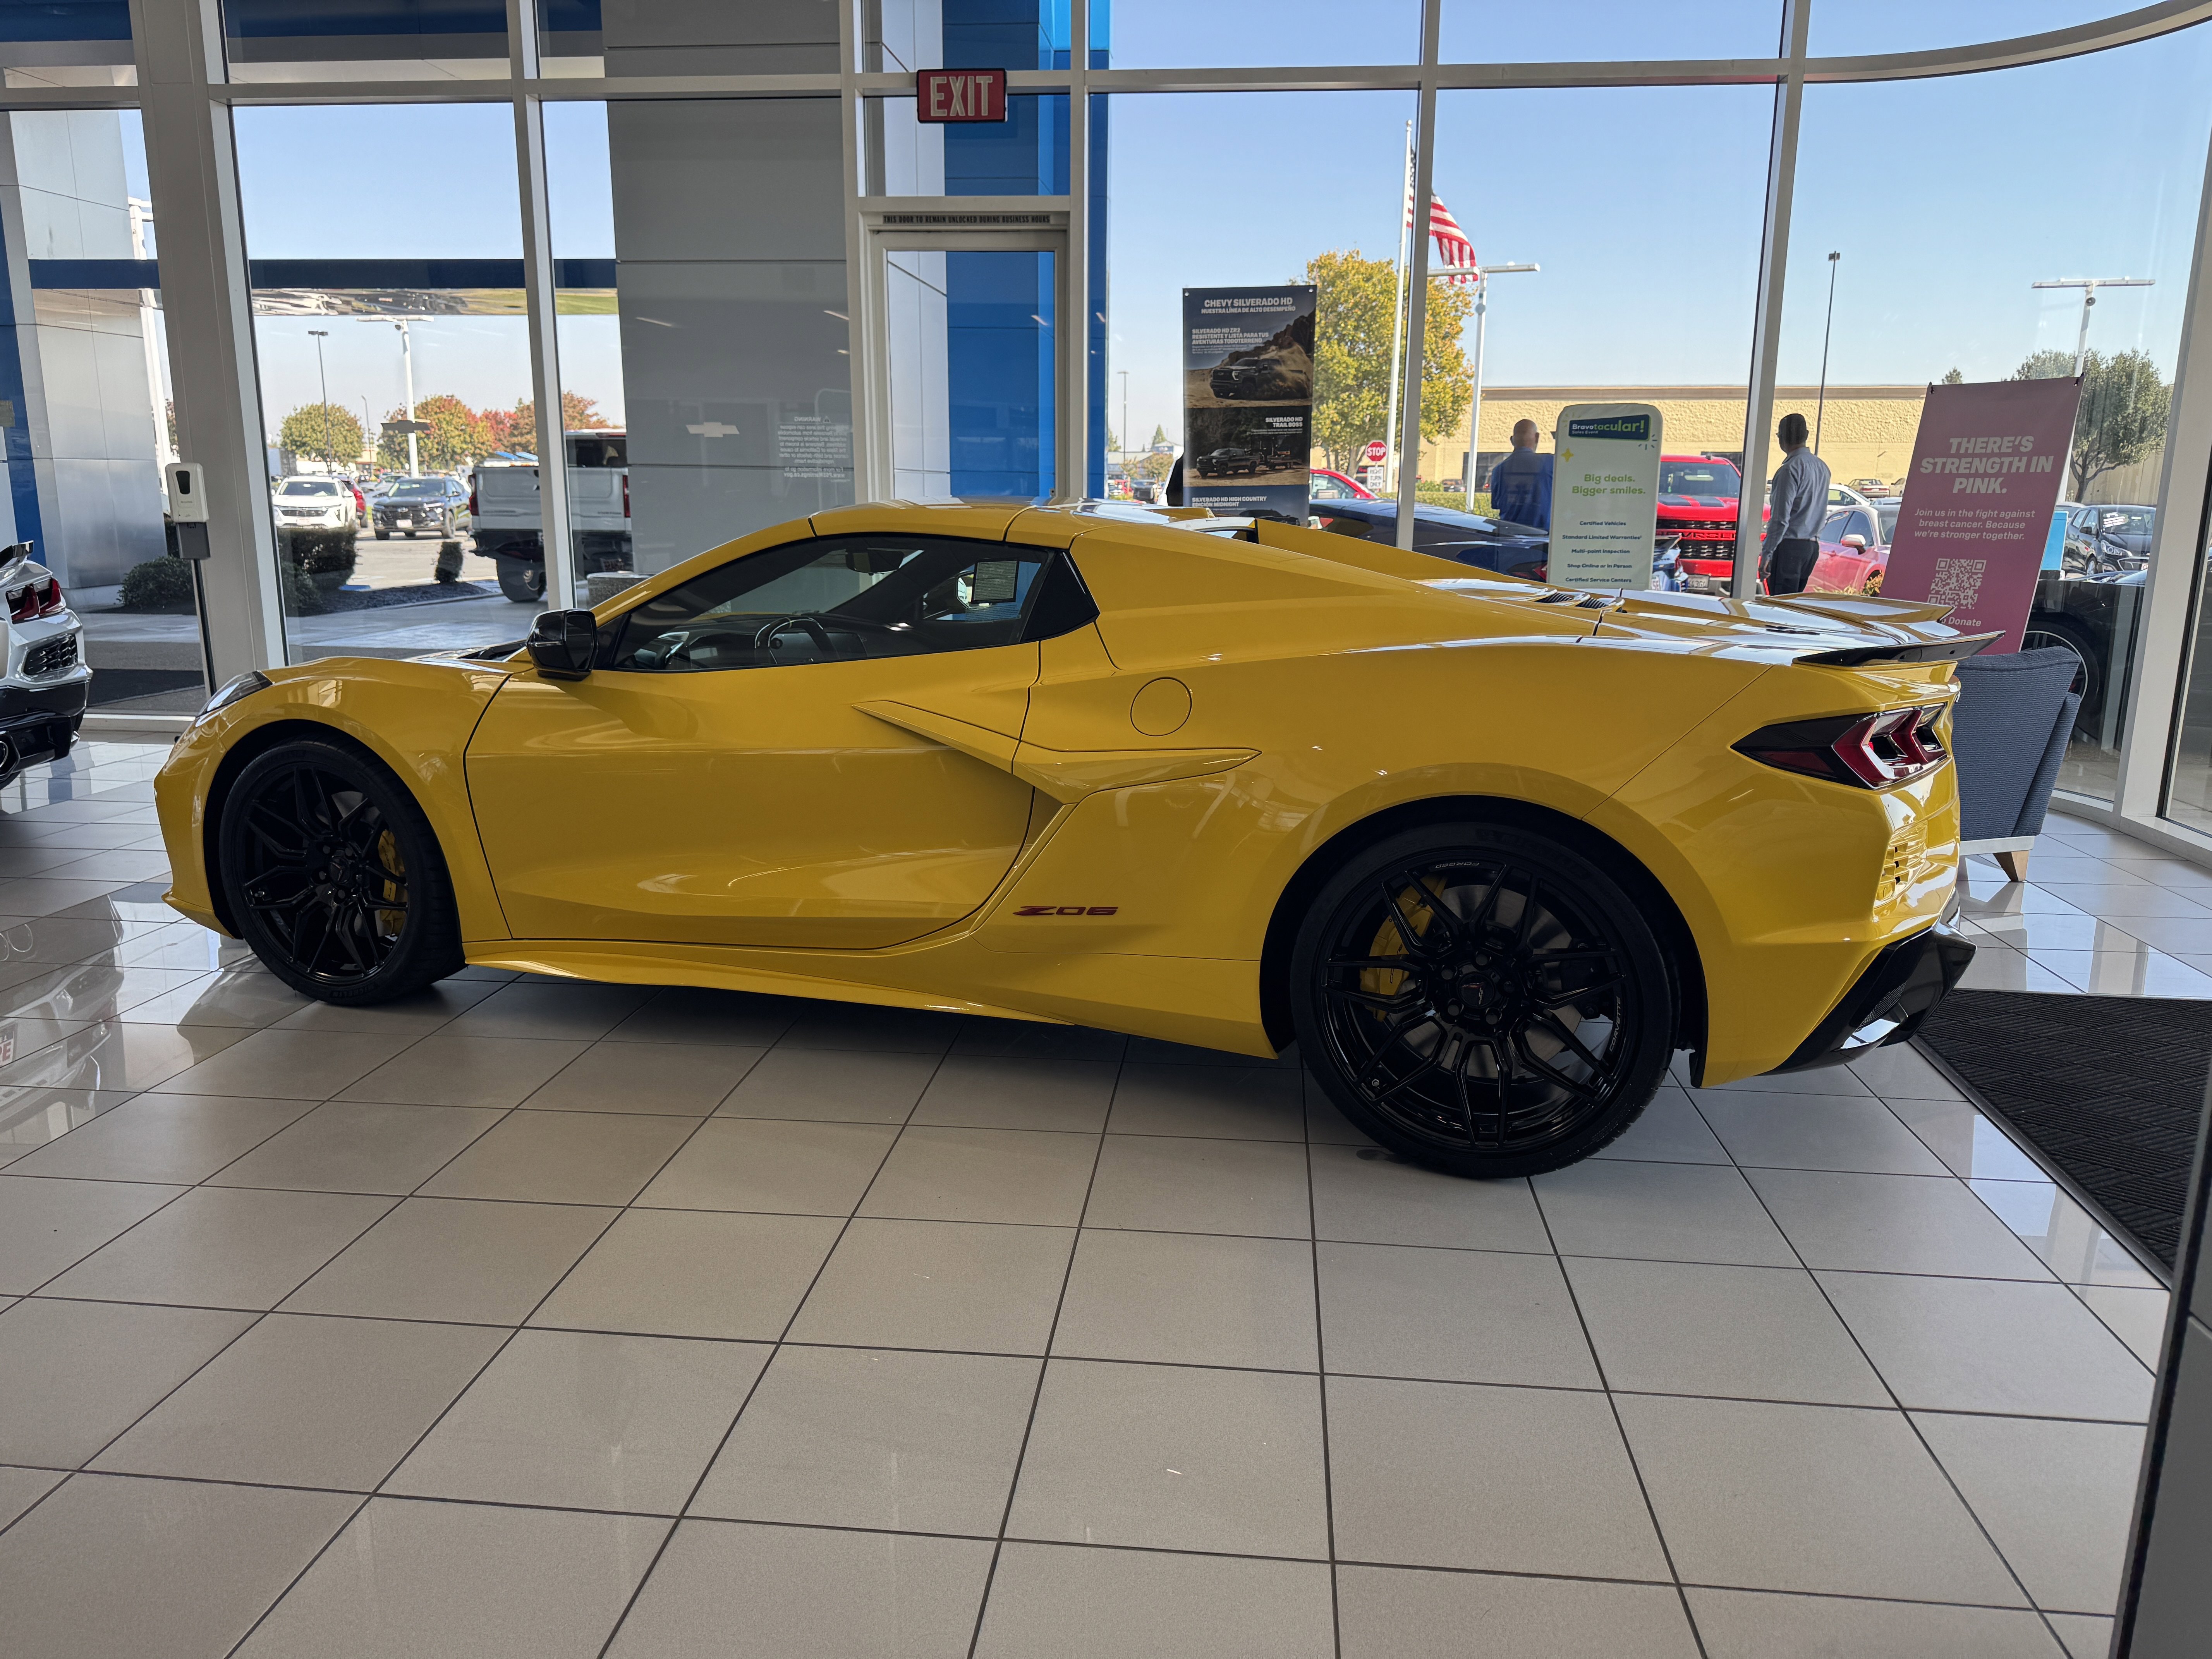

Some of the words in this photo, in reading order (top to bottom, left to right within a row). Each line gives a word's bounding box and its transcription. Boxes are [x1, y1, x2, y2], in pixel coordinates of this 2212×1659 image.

[930, 76, 993, 117] EXIT
[1204, 299, 1232, 307] CHEVY
[1233, 298, 1279, 306] SILVERADO
[1572, 420, 1644, 433] Bravotacular!
[1949, 435, 2034, 453] THERE'S
[1367, 447, 1386, 456] STOP
[1920, 457, 2027, 473] STRENGTH
[2030, 456, 2054, 472] IN
[1584, 474, 1601, 484] Big
[1953, 477, 2007, 493] PINK.
[1572, 486, 1607, 496] Bigger
[1915, 508, 1933, 517] Join
[1948, 508, 1956, 517] in
[1976, 509, 1997, 519] fight
[2000, 510, 2035, 519] against
[1919, 519, 1949, 527] breast
[1950, 519, 1982, 528] cancer.
[1985, 520, 2025, 529] Because
[1914, 529, 1939, 538] we're
[1941, 530, 1981, 539] stronger
[1983, 531, 2025, 541] together.
[1948, 617, 1981, 627] Donate
[1013, 906, 1118, 915] Z06
[1609, 996, 1621, 1052] CORVETTE
